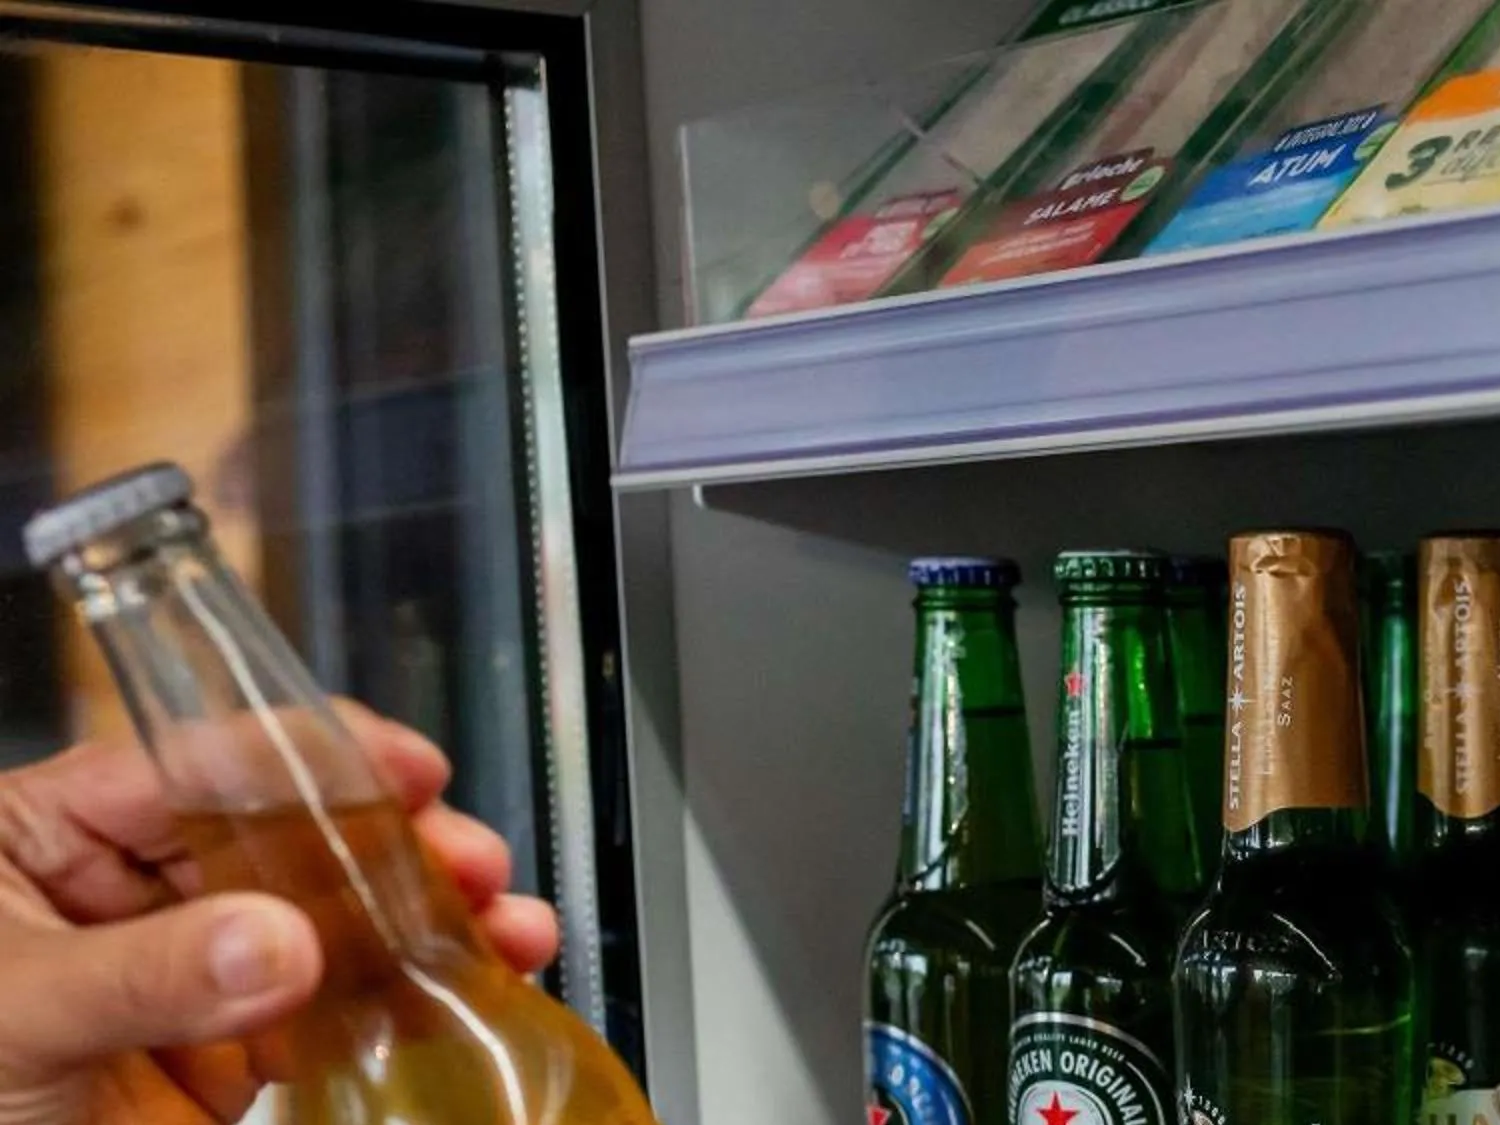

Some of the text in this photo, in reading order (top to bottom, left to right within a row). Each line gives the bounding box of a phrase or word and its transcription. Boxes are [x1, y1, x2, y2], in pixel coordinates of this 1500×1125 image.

[1247, 144, 1347, 187] ATUM
[1384, 135, 1454, 190] 3
[1228, 581, 1247, 810] STELLA ARTOIS
